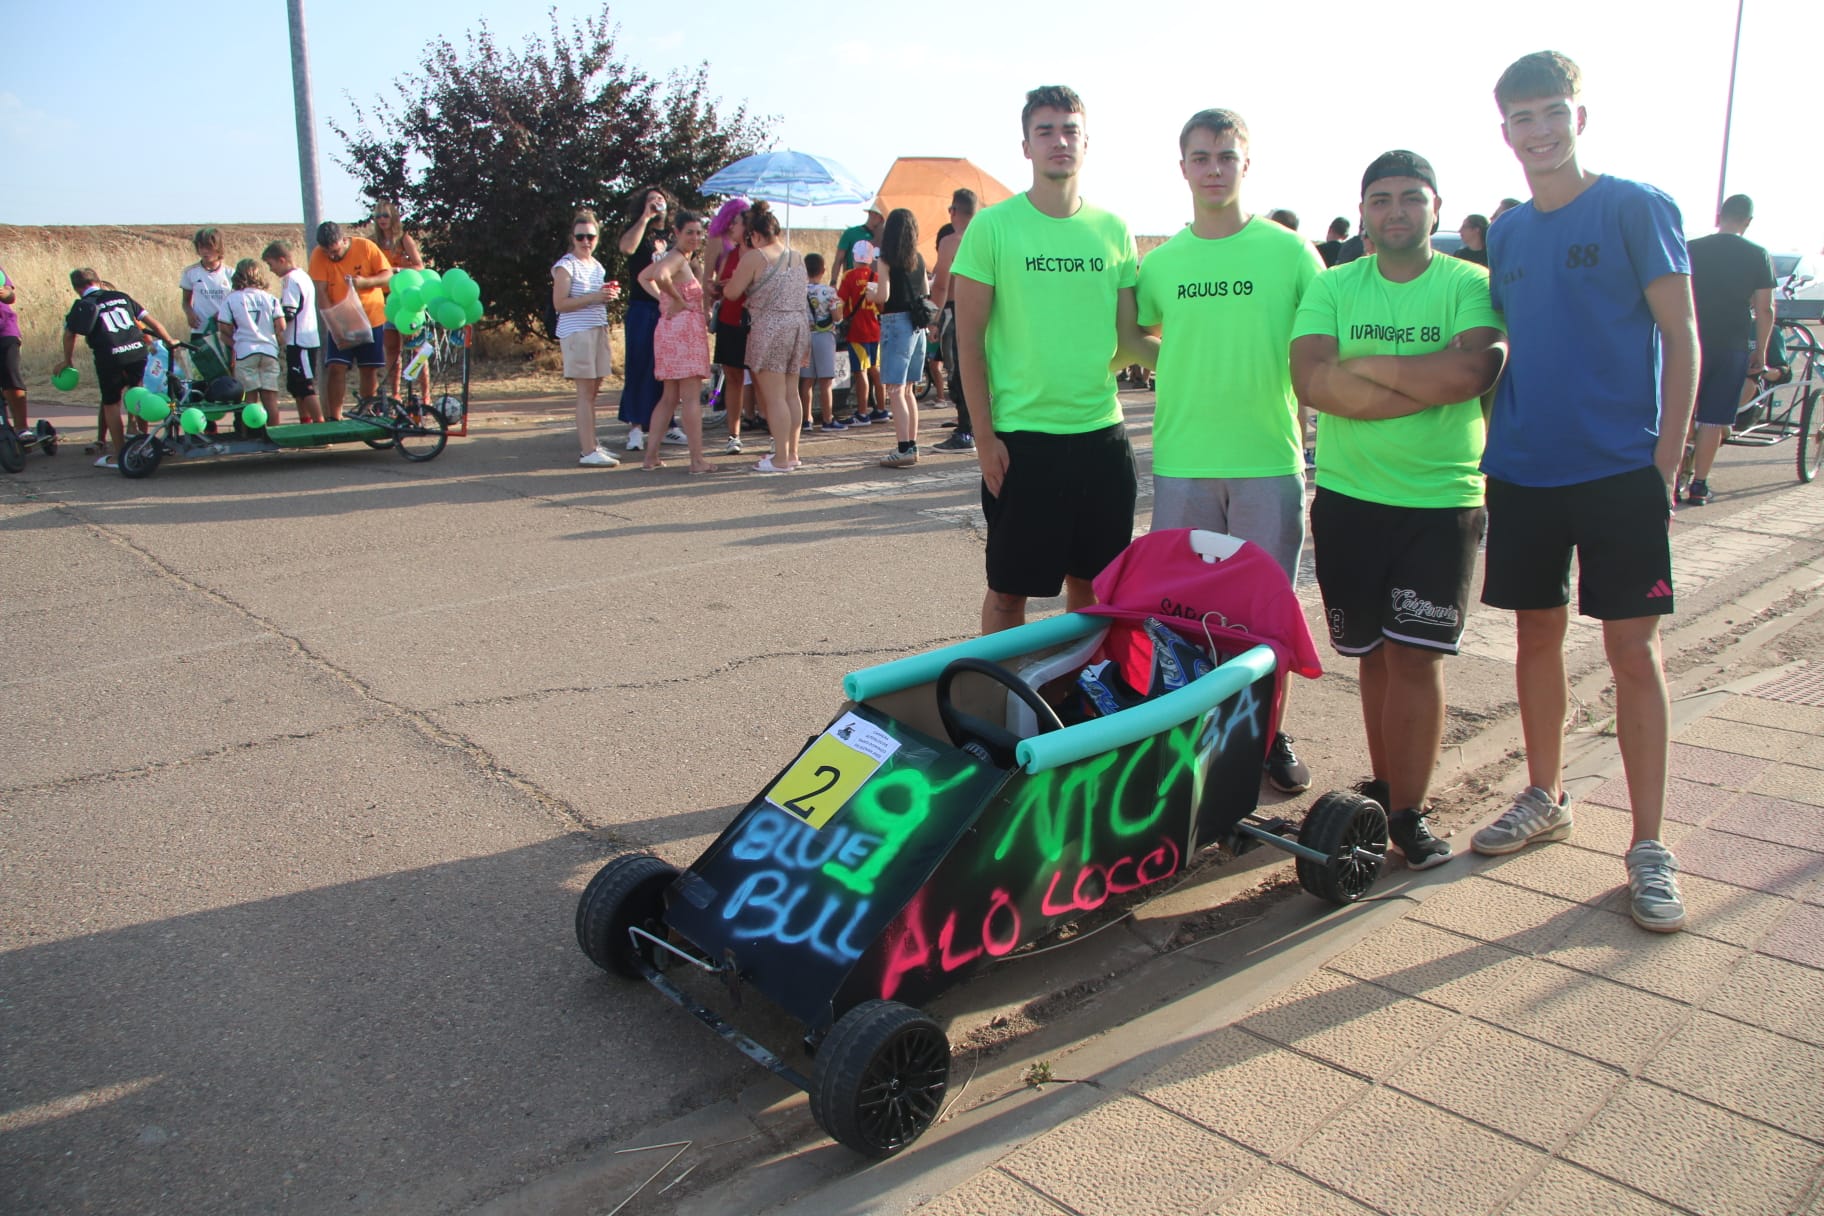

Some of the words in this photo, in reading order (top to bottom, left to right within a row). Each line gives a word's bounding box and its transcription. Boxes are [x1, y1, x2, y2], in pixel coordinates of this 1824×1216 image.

[1025, 253, 1085, 273] HÉCTOR
[1089, 257, 1104, 272] 10
[1566, 243, 1600, 270] 88
[1177, 281, 1228, 300] AGUUS
[1232, 280, 1254, 296] 09
[100, 306, 135, 333] 10
[1350, 324, 1415, 344] IVANGRE
[1420, 326, 1441, 343] 88
[783, 765, 841, 820] 2
[731, 808, 882, 869] BLUE
[1041, 836, 1180, 917] LOCO
[722, 869, 872, 963] BULL
